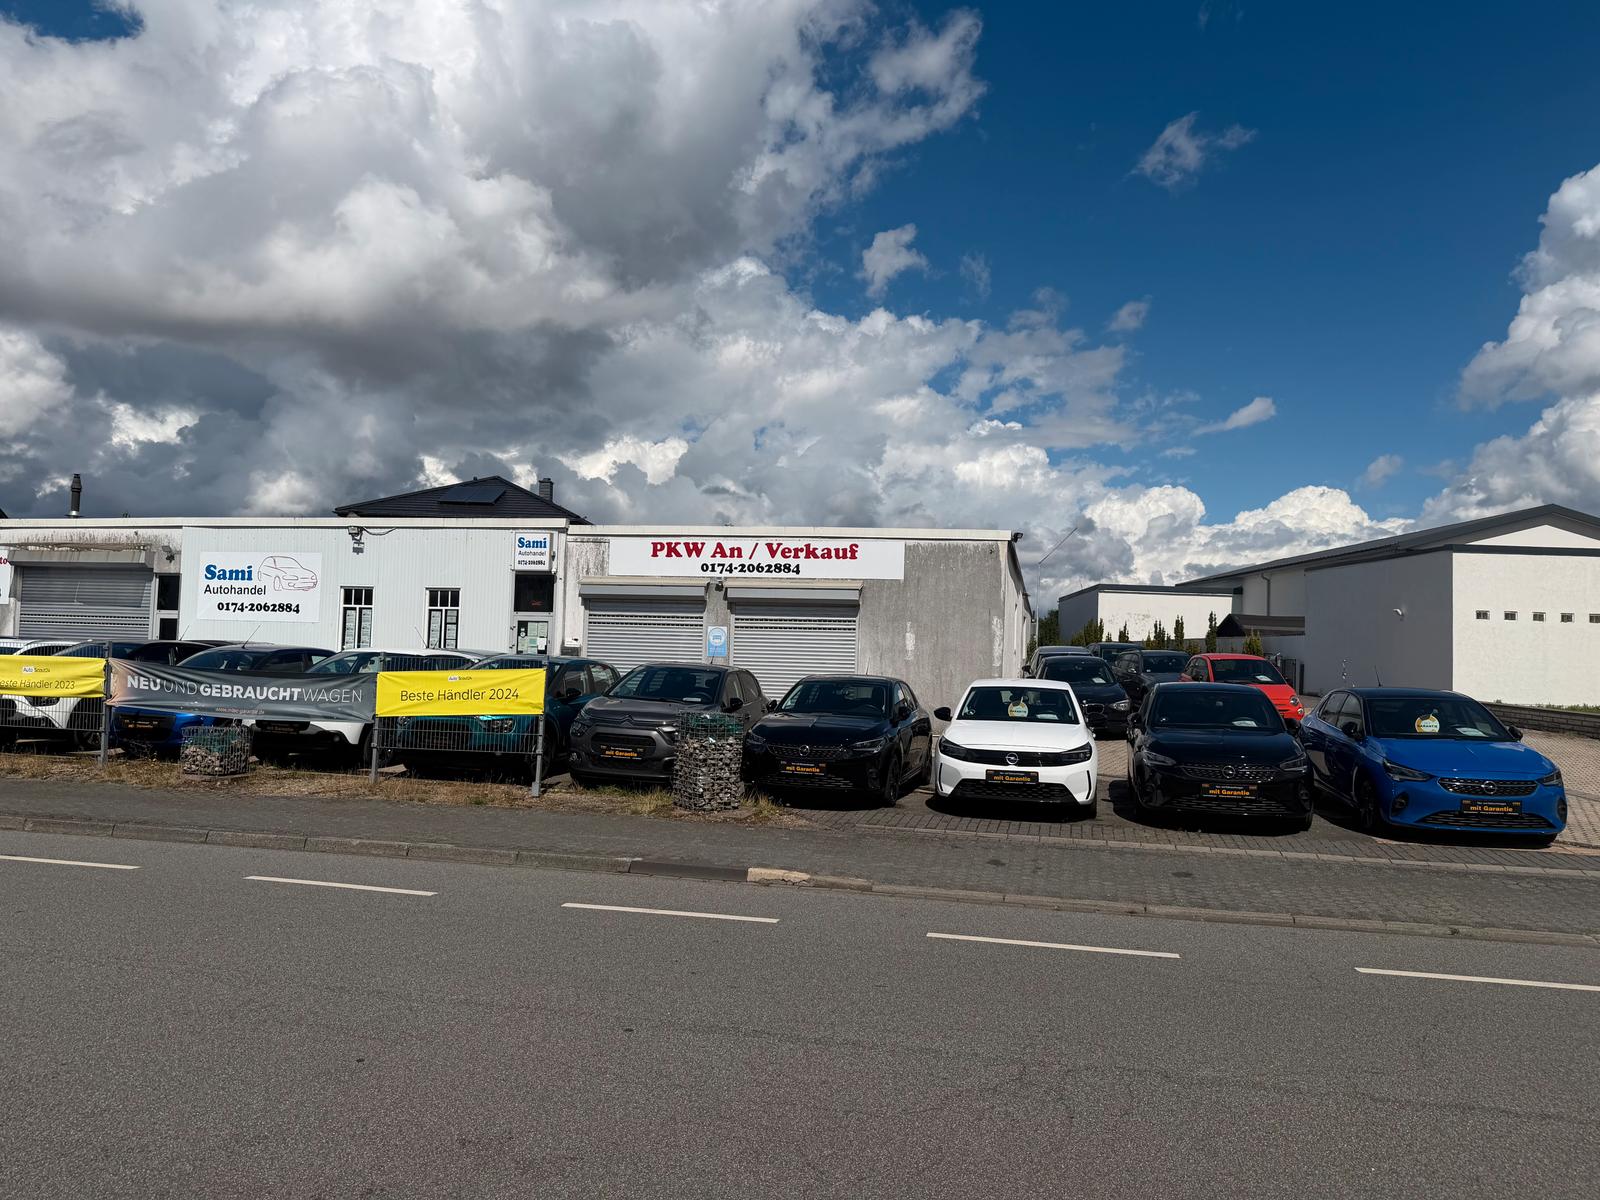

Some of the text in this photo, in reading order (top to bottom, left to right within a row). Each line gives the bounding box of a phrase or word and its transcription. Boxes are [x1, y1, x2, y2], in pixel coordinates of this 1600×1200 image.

[517, 536, 547, 549] Sami
[650, 541, 860, 560] PKW An / Verkauf
[204, 564, 253, 581] Sami
[700, 562, 801, 575] 0174-2062884
[203, 584, 267, 596] Autohandel
[217, 602, 300, 614] 0174-2062884
[54, 680, 76, 690] 2023
[400, 688, 520, 702] Beste Händler 2024
